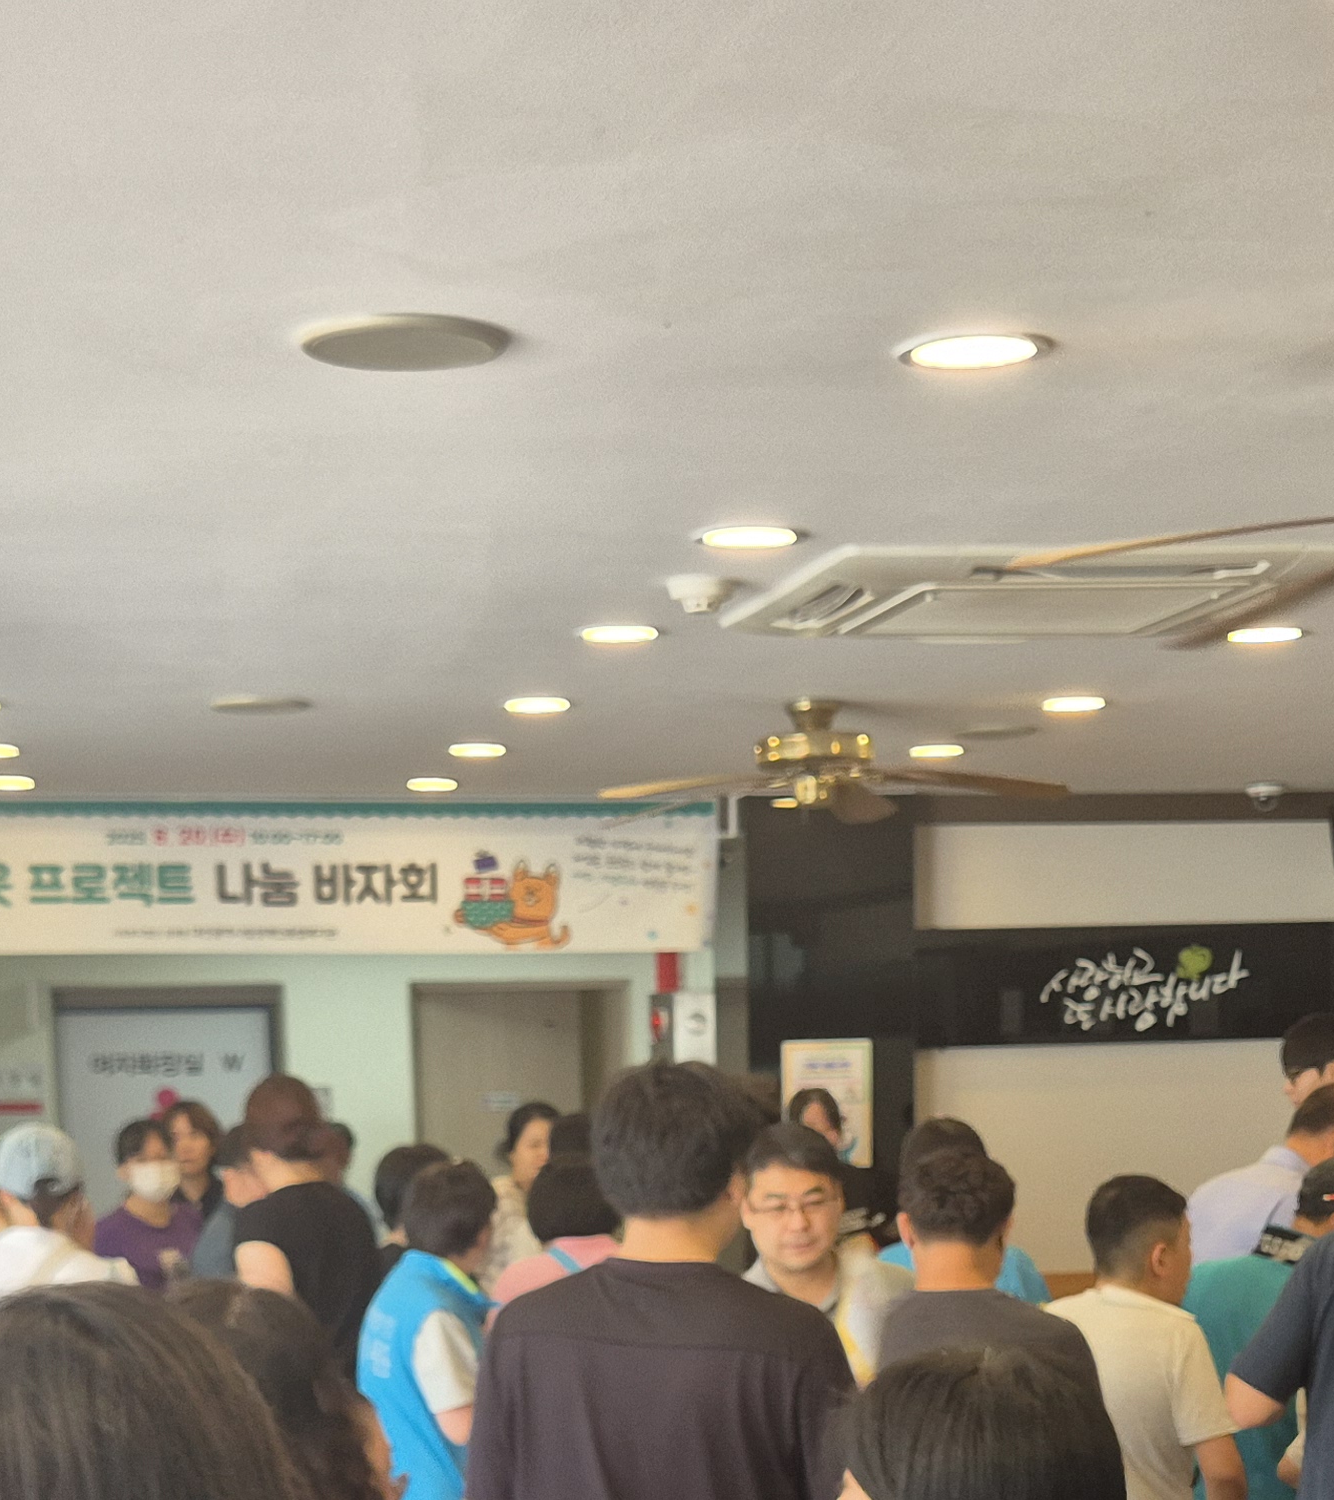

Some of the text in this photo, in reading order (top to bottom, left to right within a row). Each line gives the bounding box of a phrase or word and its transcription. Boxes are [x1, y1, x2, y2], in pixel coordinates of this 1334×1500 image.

[28, 861, 196, 908] 프로젝트
[215, 861, 300, 908] 나눔
[313, 862, 439, 906] 바자회
